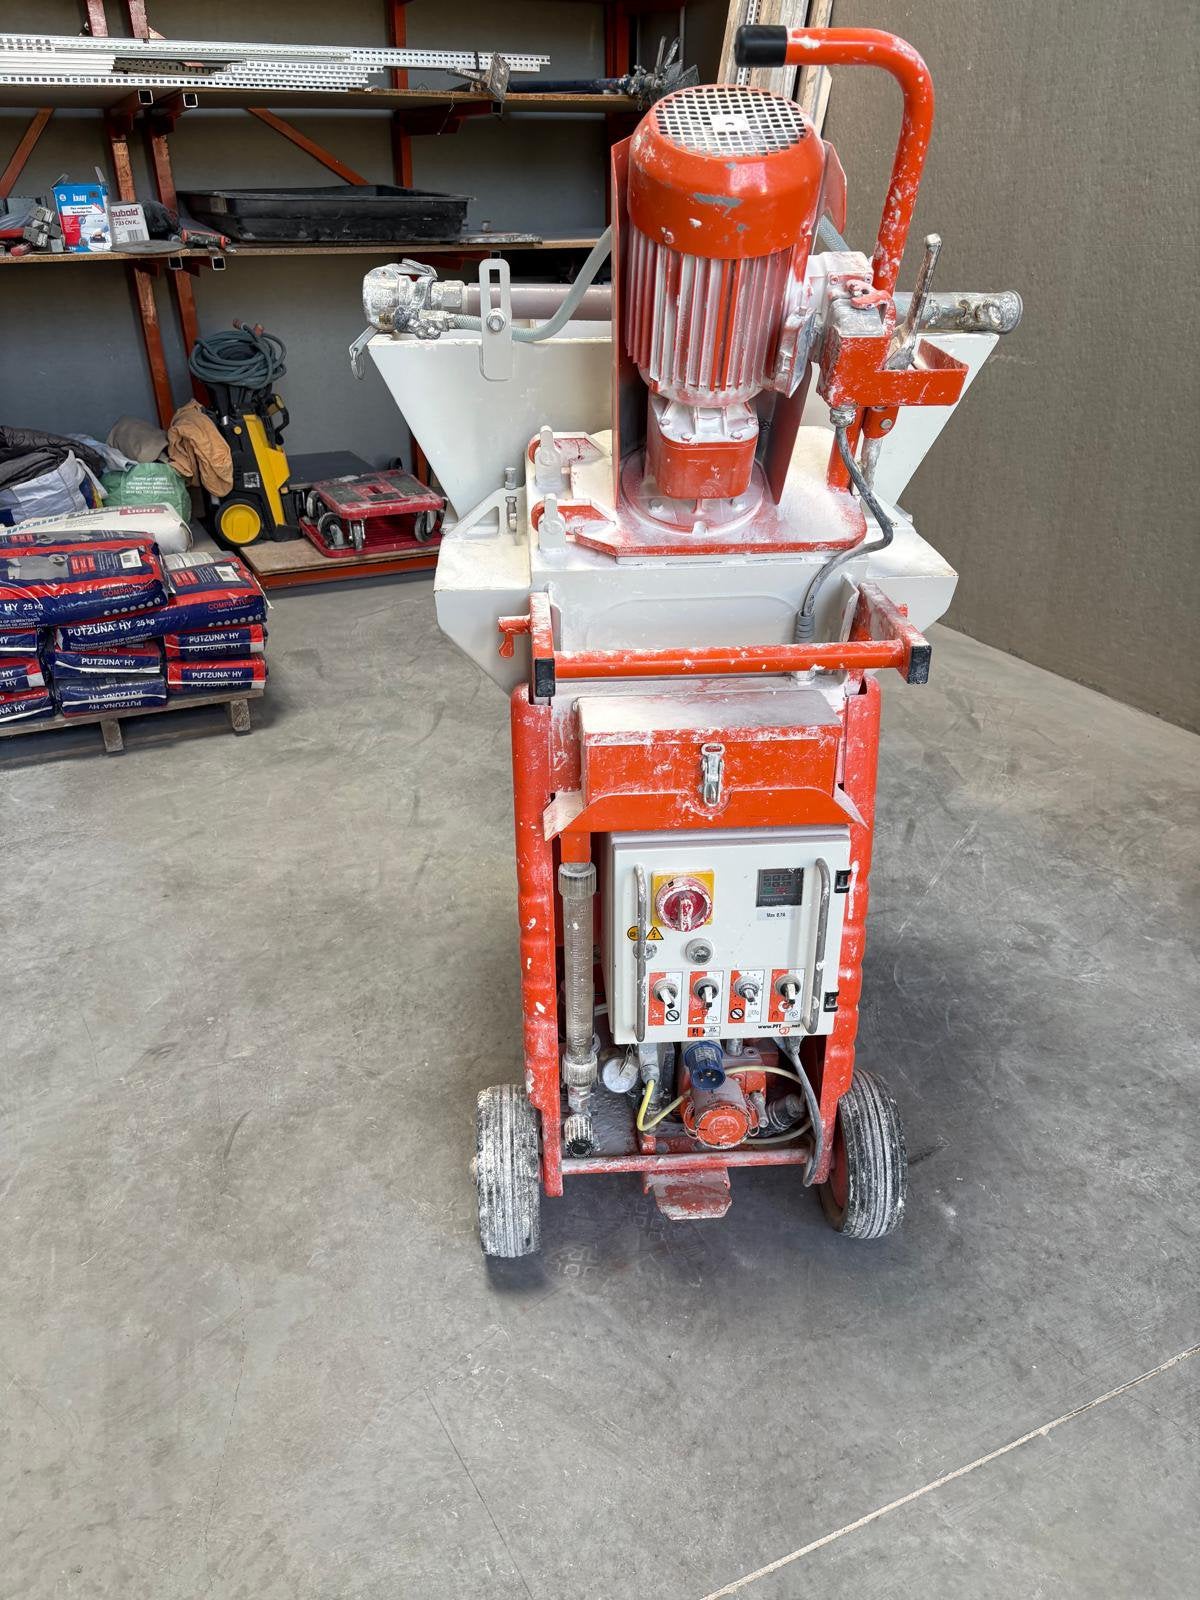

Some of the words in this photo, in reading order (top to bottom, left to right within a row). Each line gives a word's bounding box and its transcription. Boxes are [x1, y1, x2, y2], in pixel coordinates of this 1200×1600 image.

[4, 603, 18, 611] HY
[119, 620, 132, 632] HY
[1, 669, 14, 677] HY
[14, 703, 26, 712] HY
